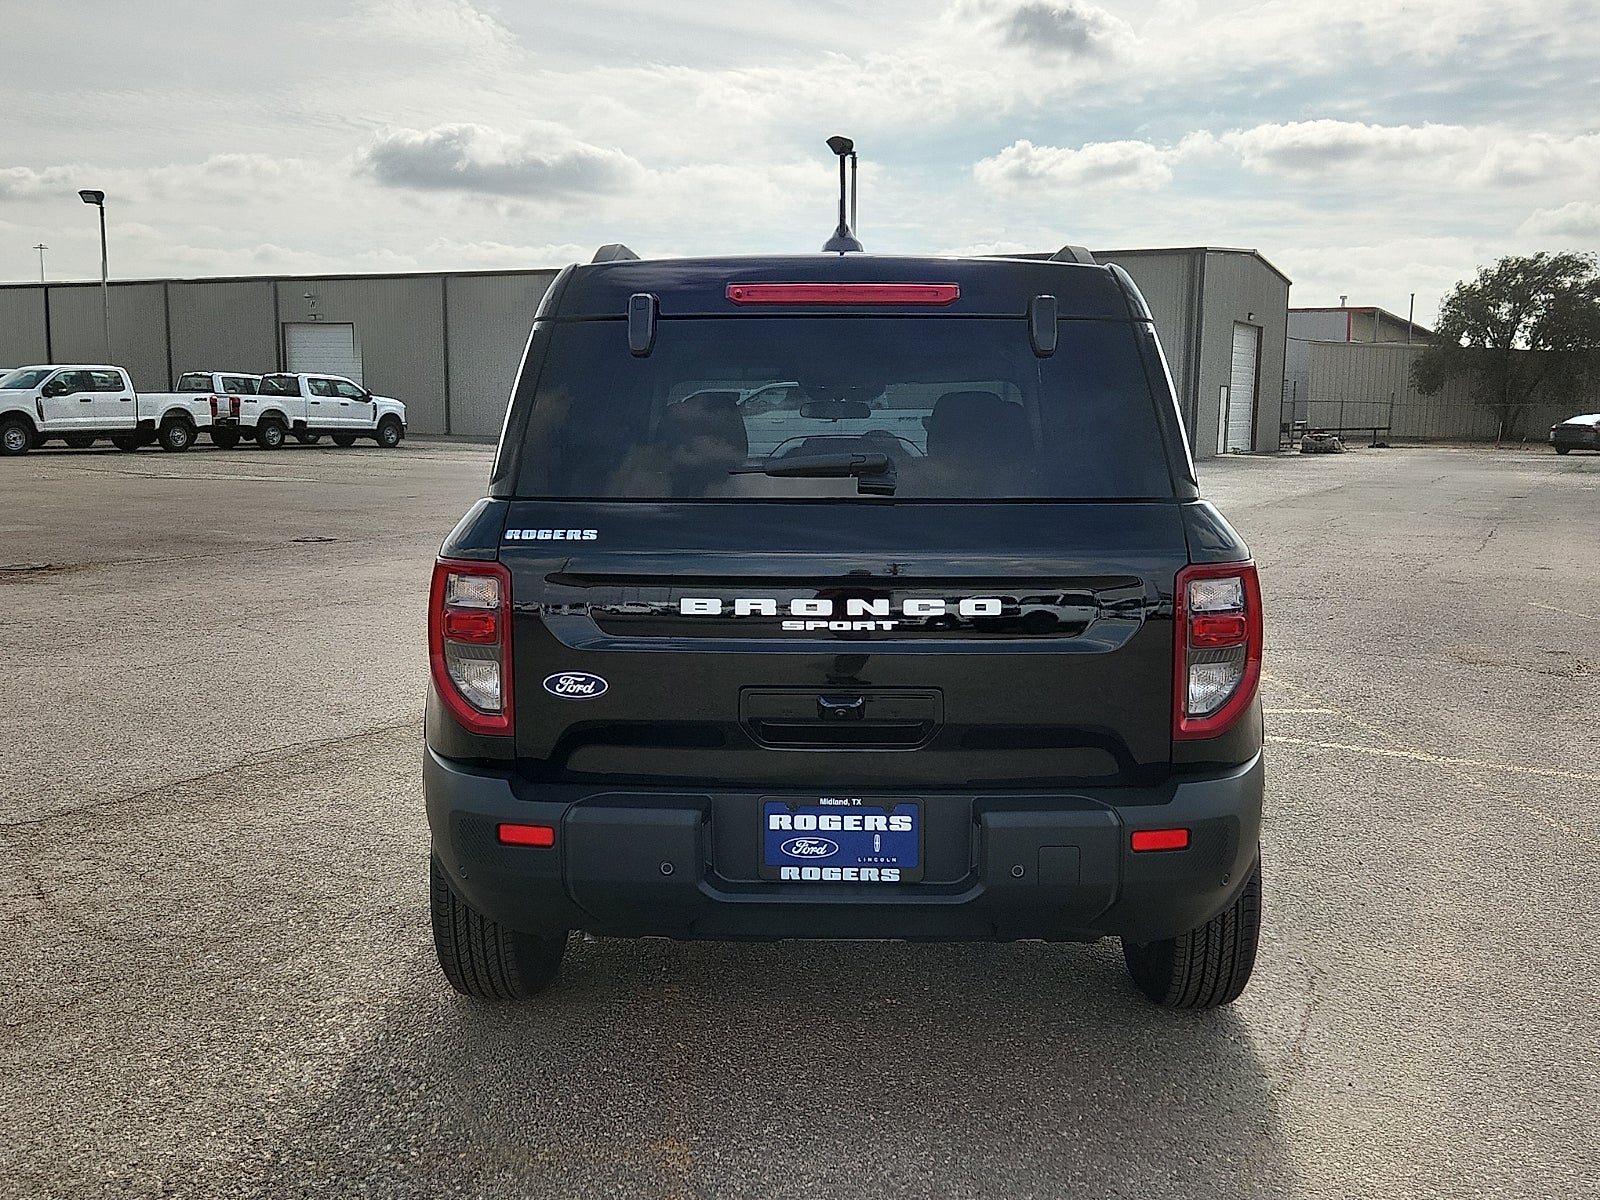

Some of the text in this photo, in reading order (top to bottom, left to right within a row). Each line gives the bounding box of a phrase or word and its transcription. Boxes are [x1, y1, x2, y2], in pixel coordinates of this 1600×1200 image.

[505, 529, 598, 541] ROGERS
[680, 597, 1002, 616] BRONCO
[781, 620, 899, 631] SPORT
[555, 676, 595, 694] Ford
[819, 798, 850, 806] Midland,
[769, 814, 912, 831] ROGERS
[791, 839, 827, 855] Ford
[780, 866, 900, 881] ROGERS
